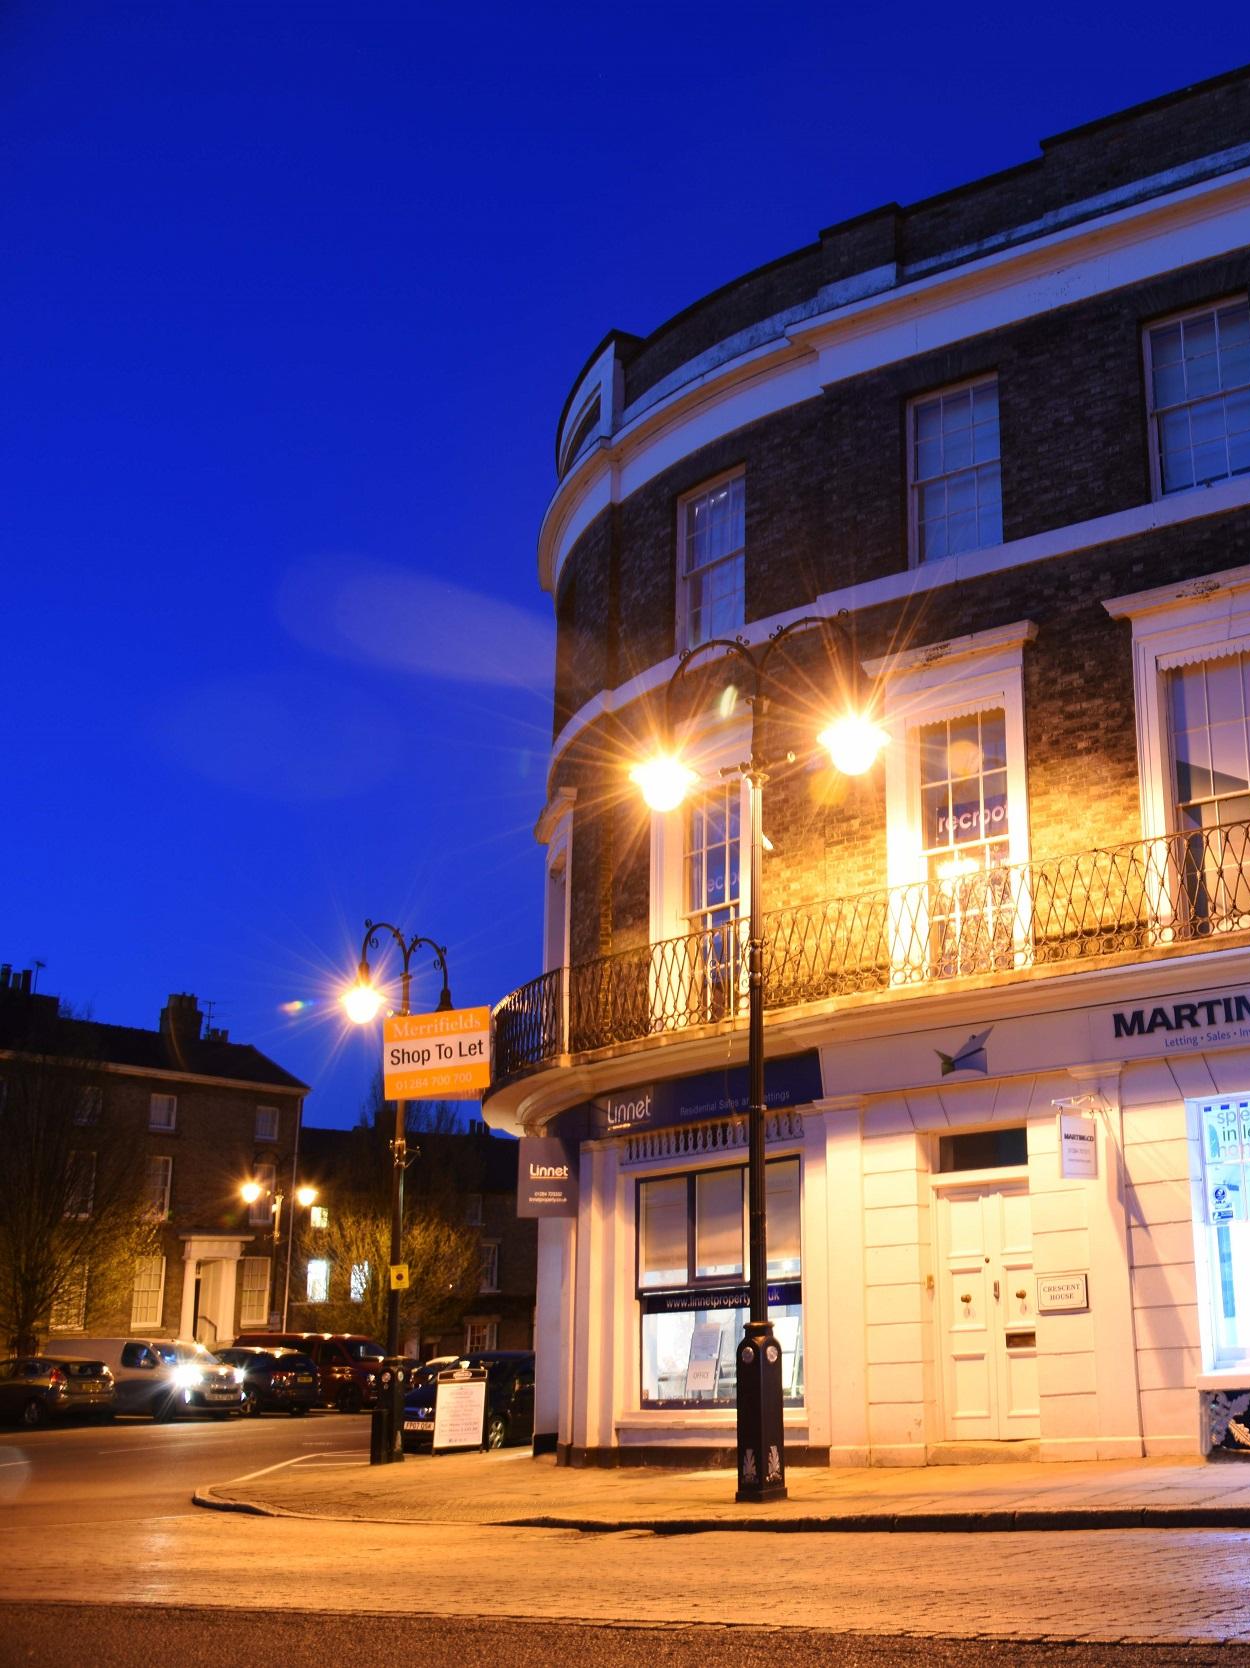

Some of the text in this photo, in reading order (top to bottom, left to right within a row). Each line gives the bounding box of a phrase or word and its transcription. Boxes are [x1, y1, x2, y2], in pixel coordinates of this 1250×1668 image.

[392, 1013, 481, 1038] Merrifields
[1164, 1031, 1199, 1048] Letting
[1206, 1030, 1231, 1042] Sales
[390, 1039, 484, 1067] Shop To Let
[764, 1090, 790, 1104] ettings
[607, 1095, 651, 1124] Linnet
[1222, 1126, 1238, 1142] in
[529, 1163, 569, 1178] Linnet
[1042, 1283, 1081, 1292] CRESCENT
[666, 1289, 780, 1309] www.linnetpropertyuk
[1050, 1293, 1074, 1301] HOUSE
